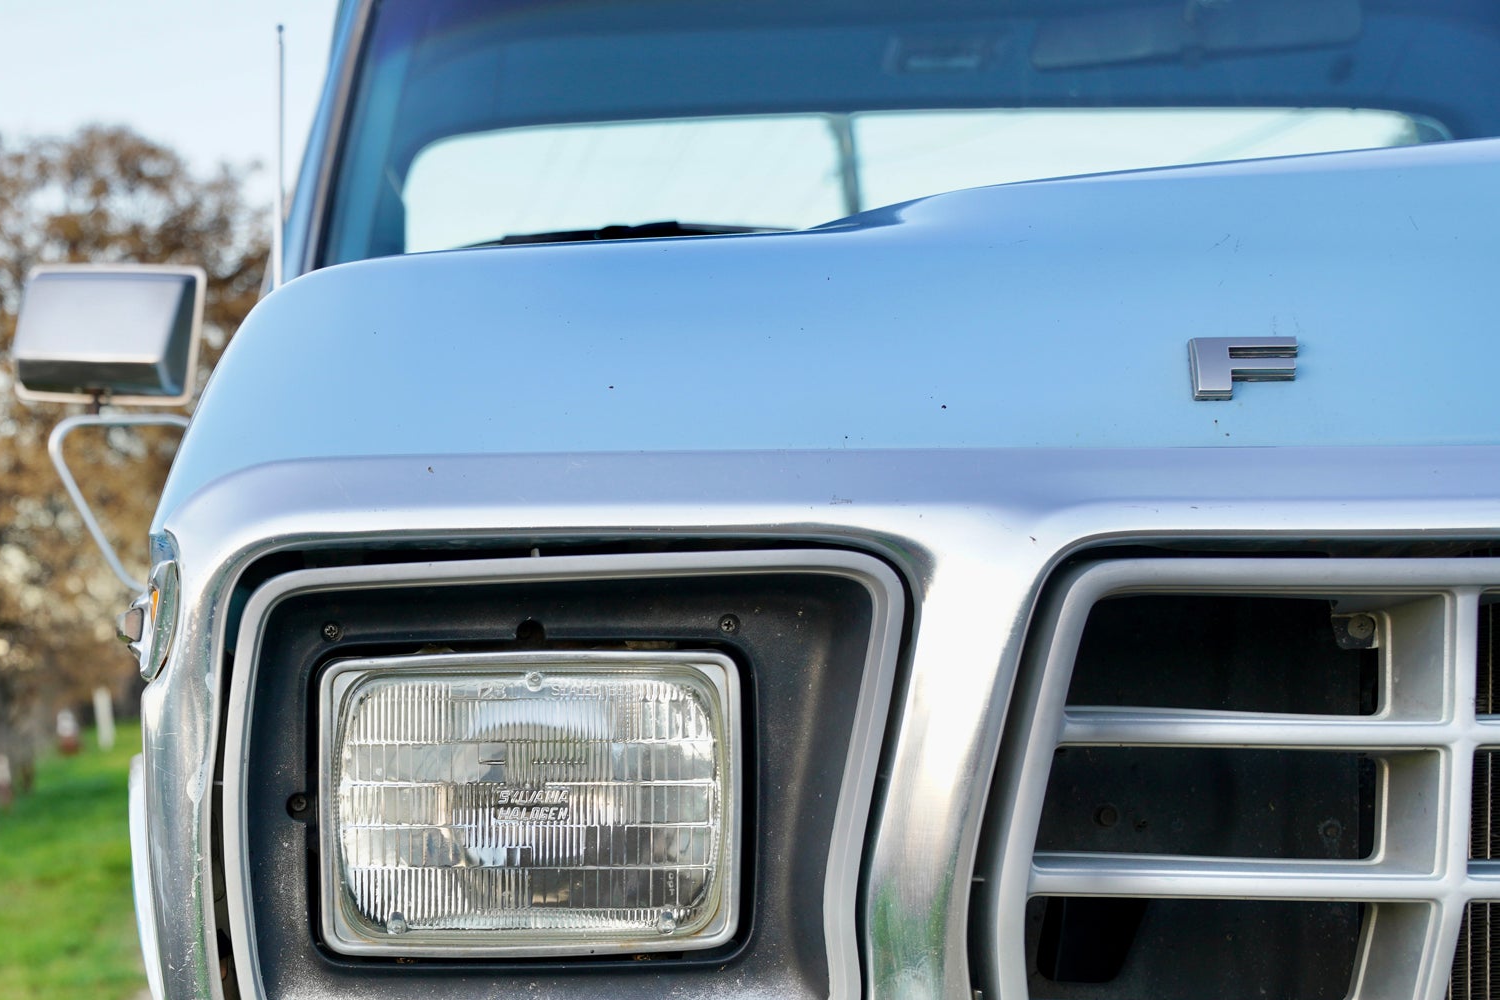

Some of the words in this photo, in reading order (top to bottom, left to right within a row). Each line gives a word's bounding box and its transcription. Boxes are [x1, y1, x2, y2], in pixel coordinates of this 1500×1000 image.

[1187, 336, 1298, 401] F
[498, 790, 569, 804] SYLVANIA
[498, 806, 569, 820] HALOGEN
